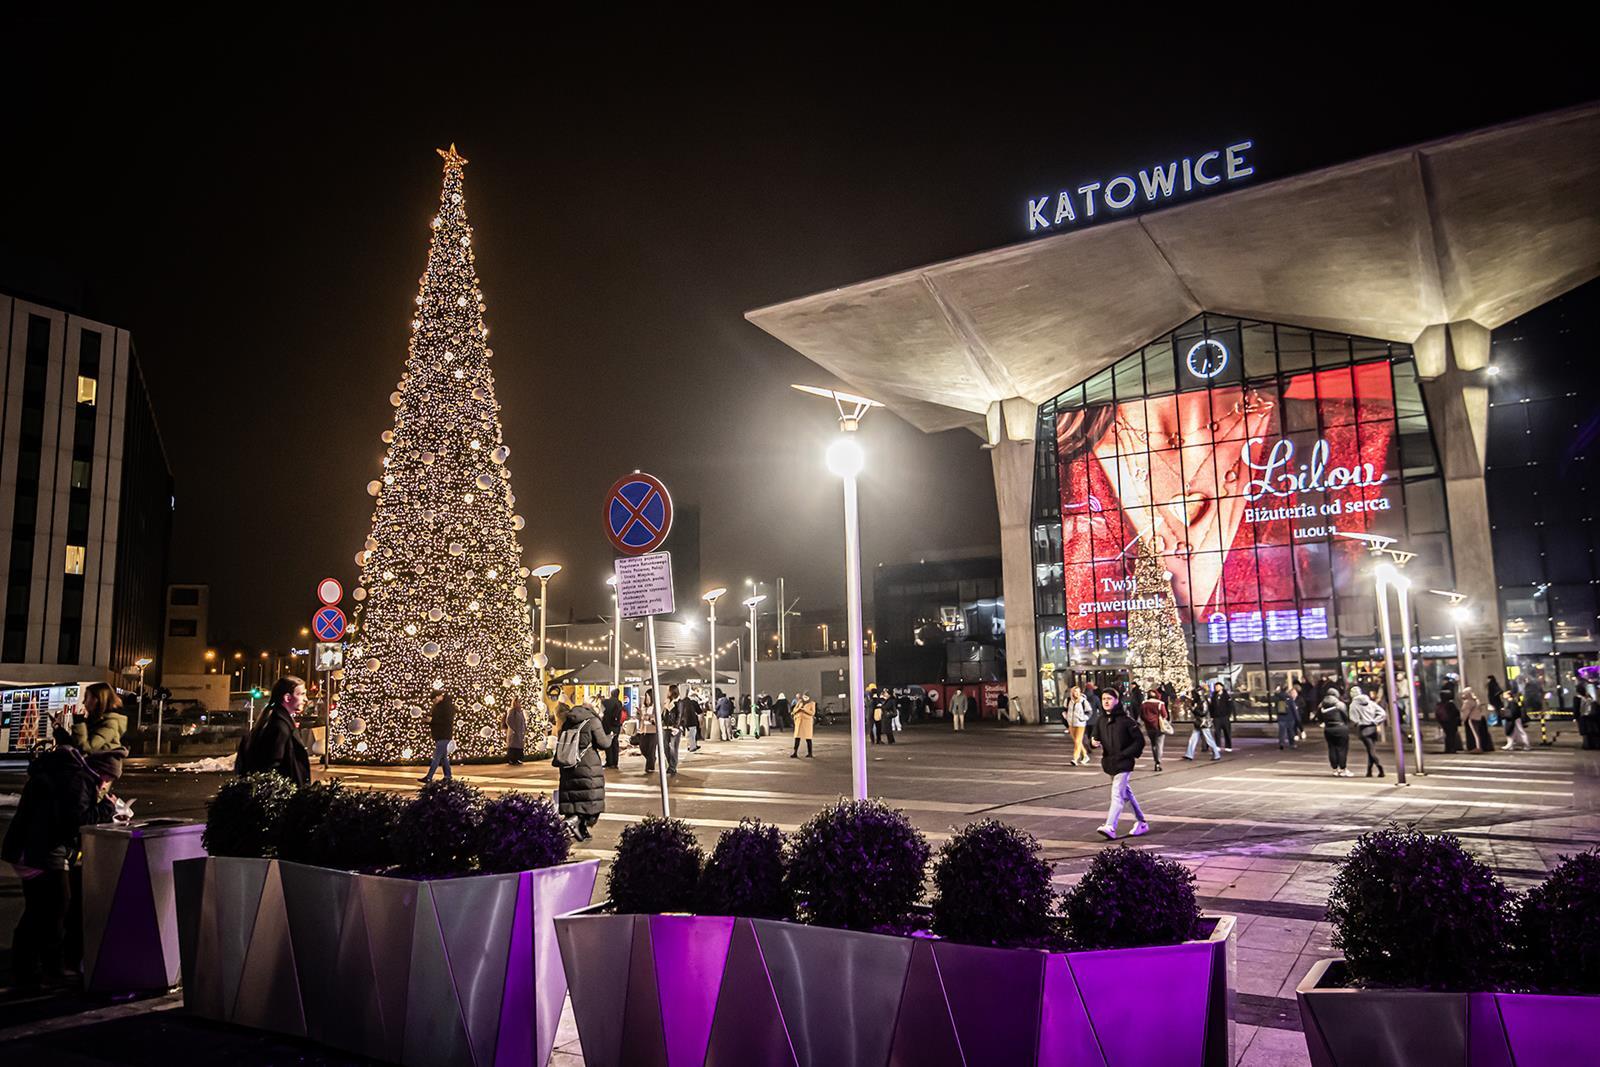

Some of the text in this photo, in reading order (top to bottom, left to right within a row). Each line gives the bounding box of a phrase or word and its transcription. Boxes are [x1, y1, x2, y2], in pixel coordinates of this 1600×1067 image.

[1028, 141, 1254, 230] KATOWICE
[1241, 438, 1388, 501] Lilou
[1244, 497, 1391, 523] Biżuteria od serca
[1101, 575, 1137, 593] Twój
[1078, 594, 1165, 616] grawerunek
